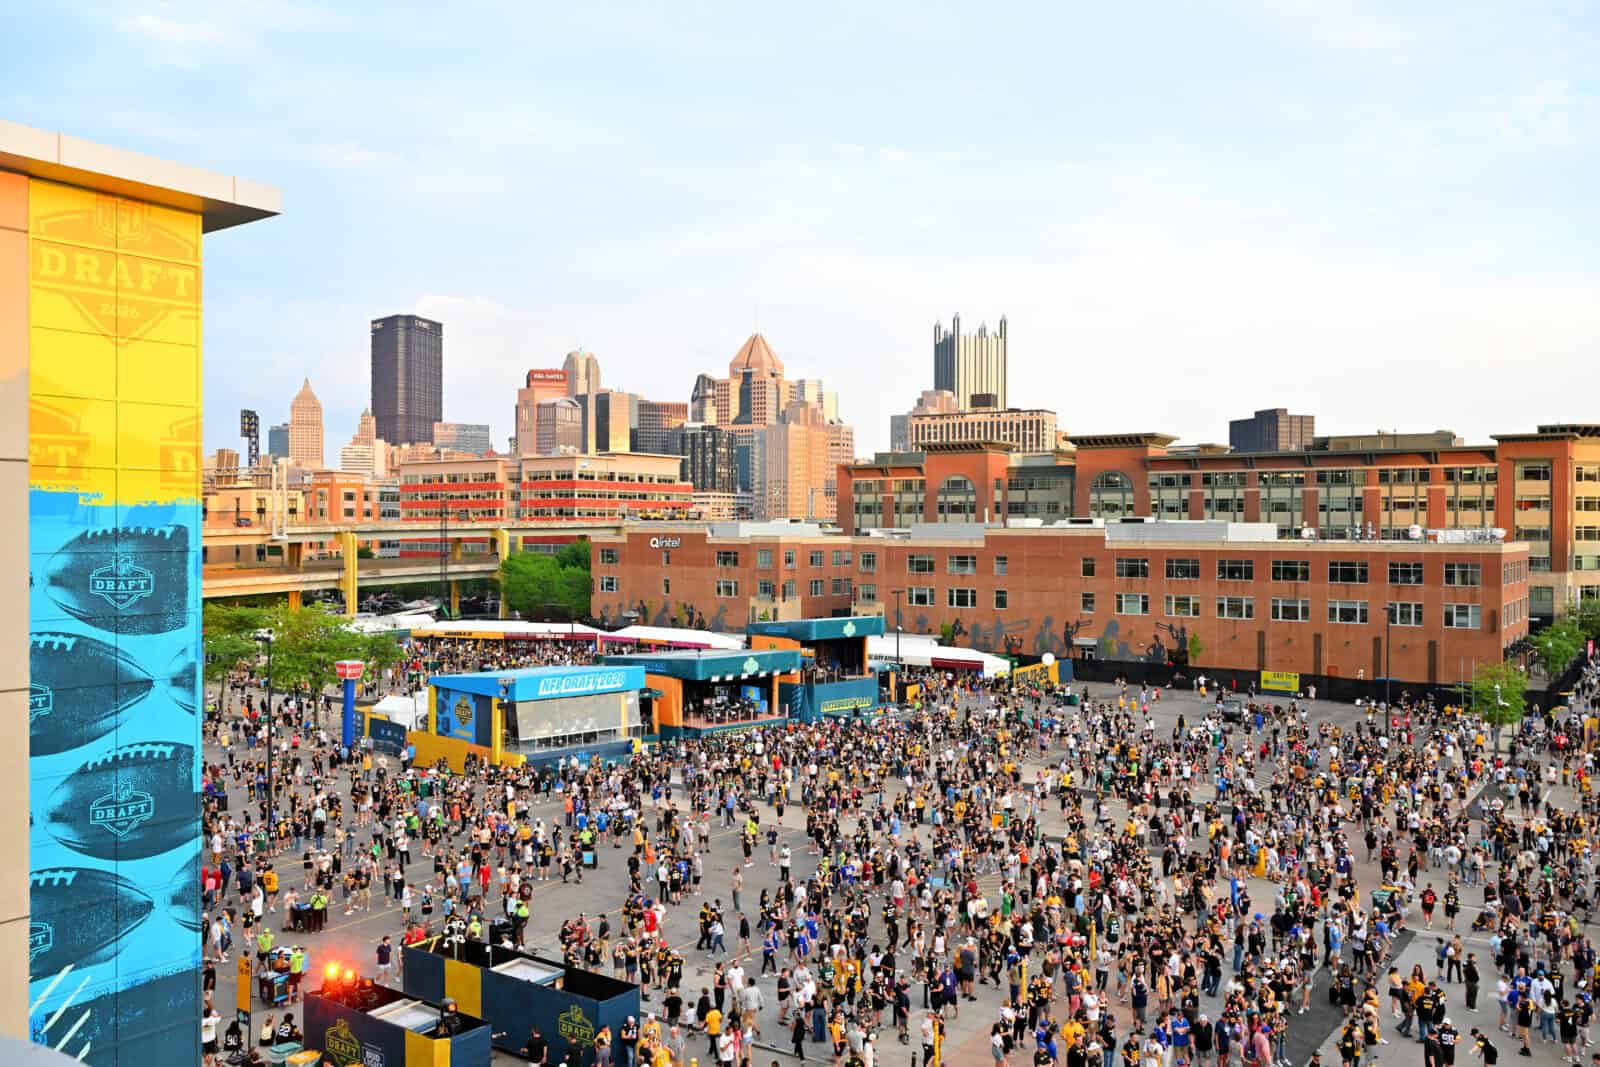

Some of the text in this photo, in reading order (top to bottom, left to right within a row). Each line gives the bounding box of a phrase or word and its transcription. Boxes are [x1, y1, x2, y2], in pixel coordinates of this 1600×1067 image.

[39, 247, 195, 297] DRAFT
[95, 580, 148, 590] DRAFT
[562, 675, 599, 692] DRAFT
[95, 803, 147, 819] DRAFT
[561, 1023, 591, 1040] DRAFT
[227, 1034, 238, 1046] 90
